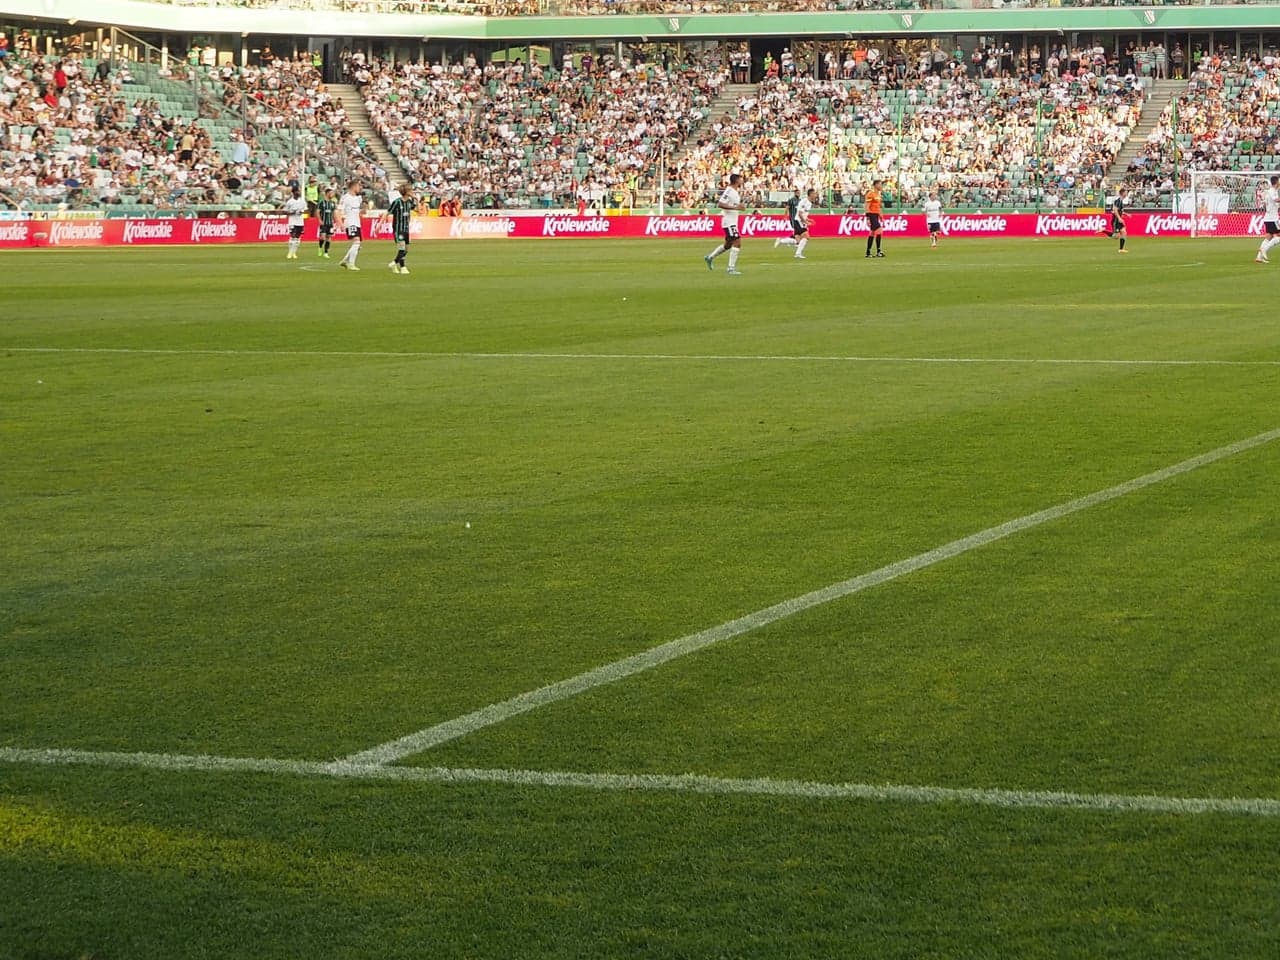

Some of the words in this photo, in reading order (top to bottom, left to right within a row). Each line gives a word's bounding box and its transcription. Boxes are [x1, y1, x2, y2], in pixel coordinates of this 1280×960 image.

[49, 220, 104, 244] Królewskie
[122, 220, 173, 243] Królewskie
[190, 219, 237, 242] Królewskie
[450, 217, 516, 237] Królewskie
[542, 217, 610, 236] Królewskie
[645, 216, 714, 236] Królewskie
[838, 216, 908, 236] Królskie
[1035, 215, 1107, 235] Królewskie
[1145, 215, 1219, 234] Królewkie
